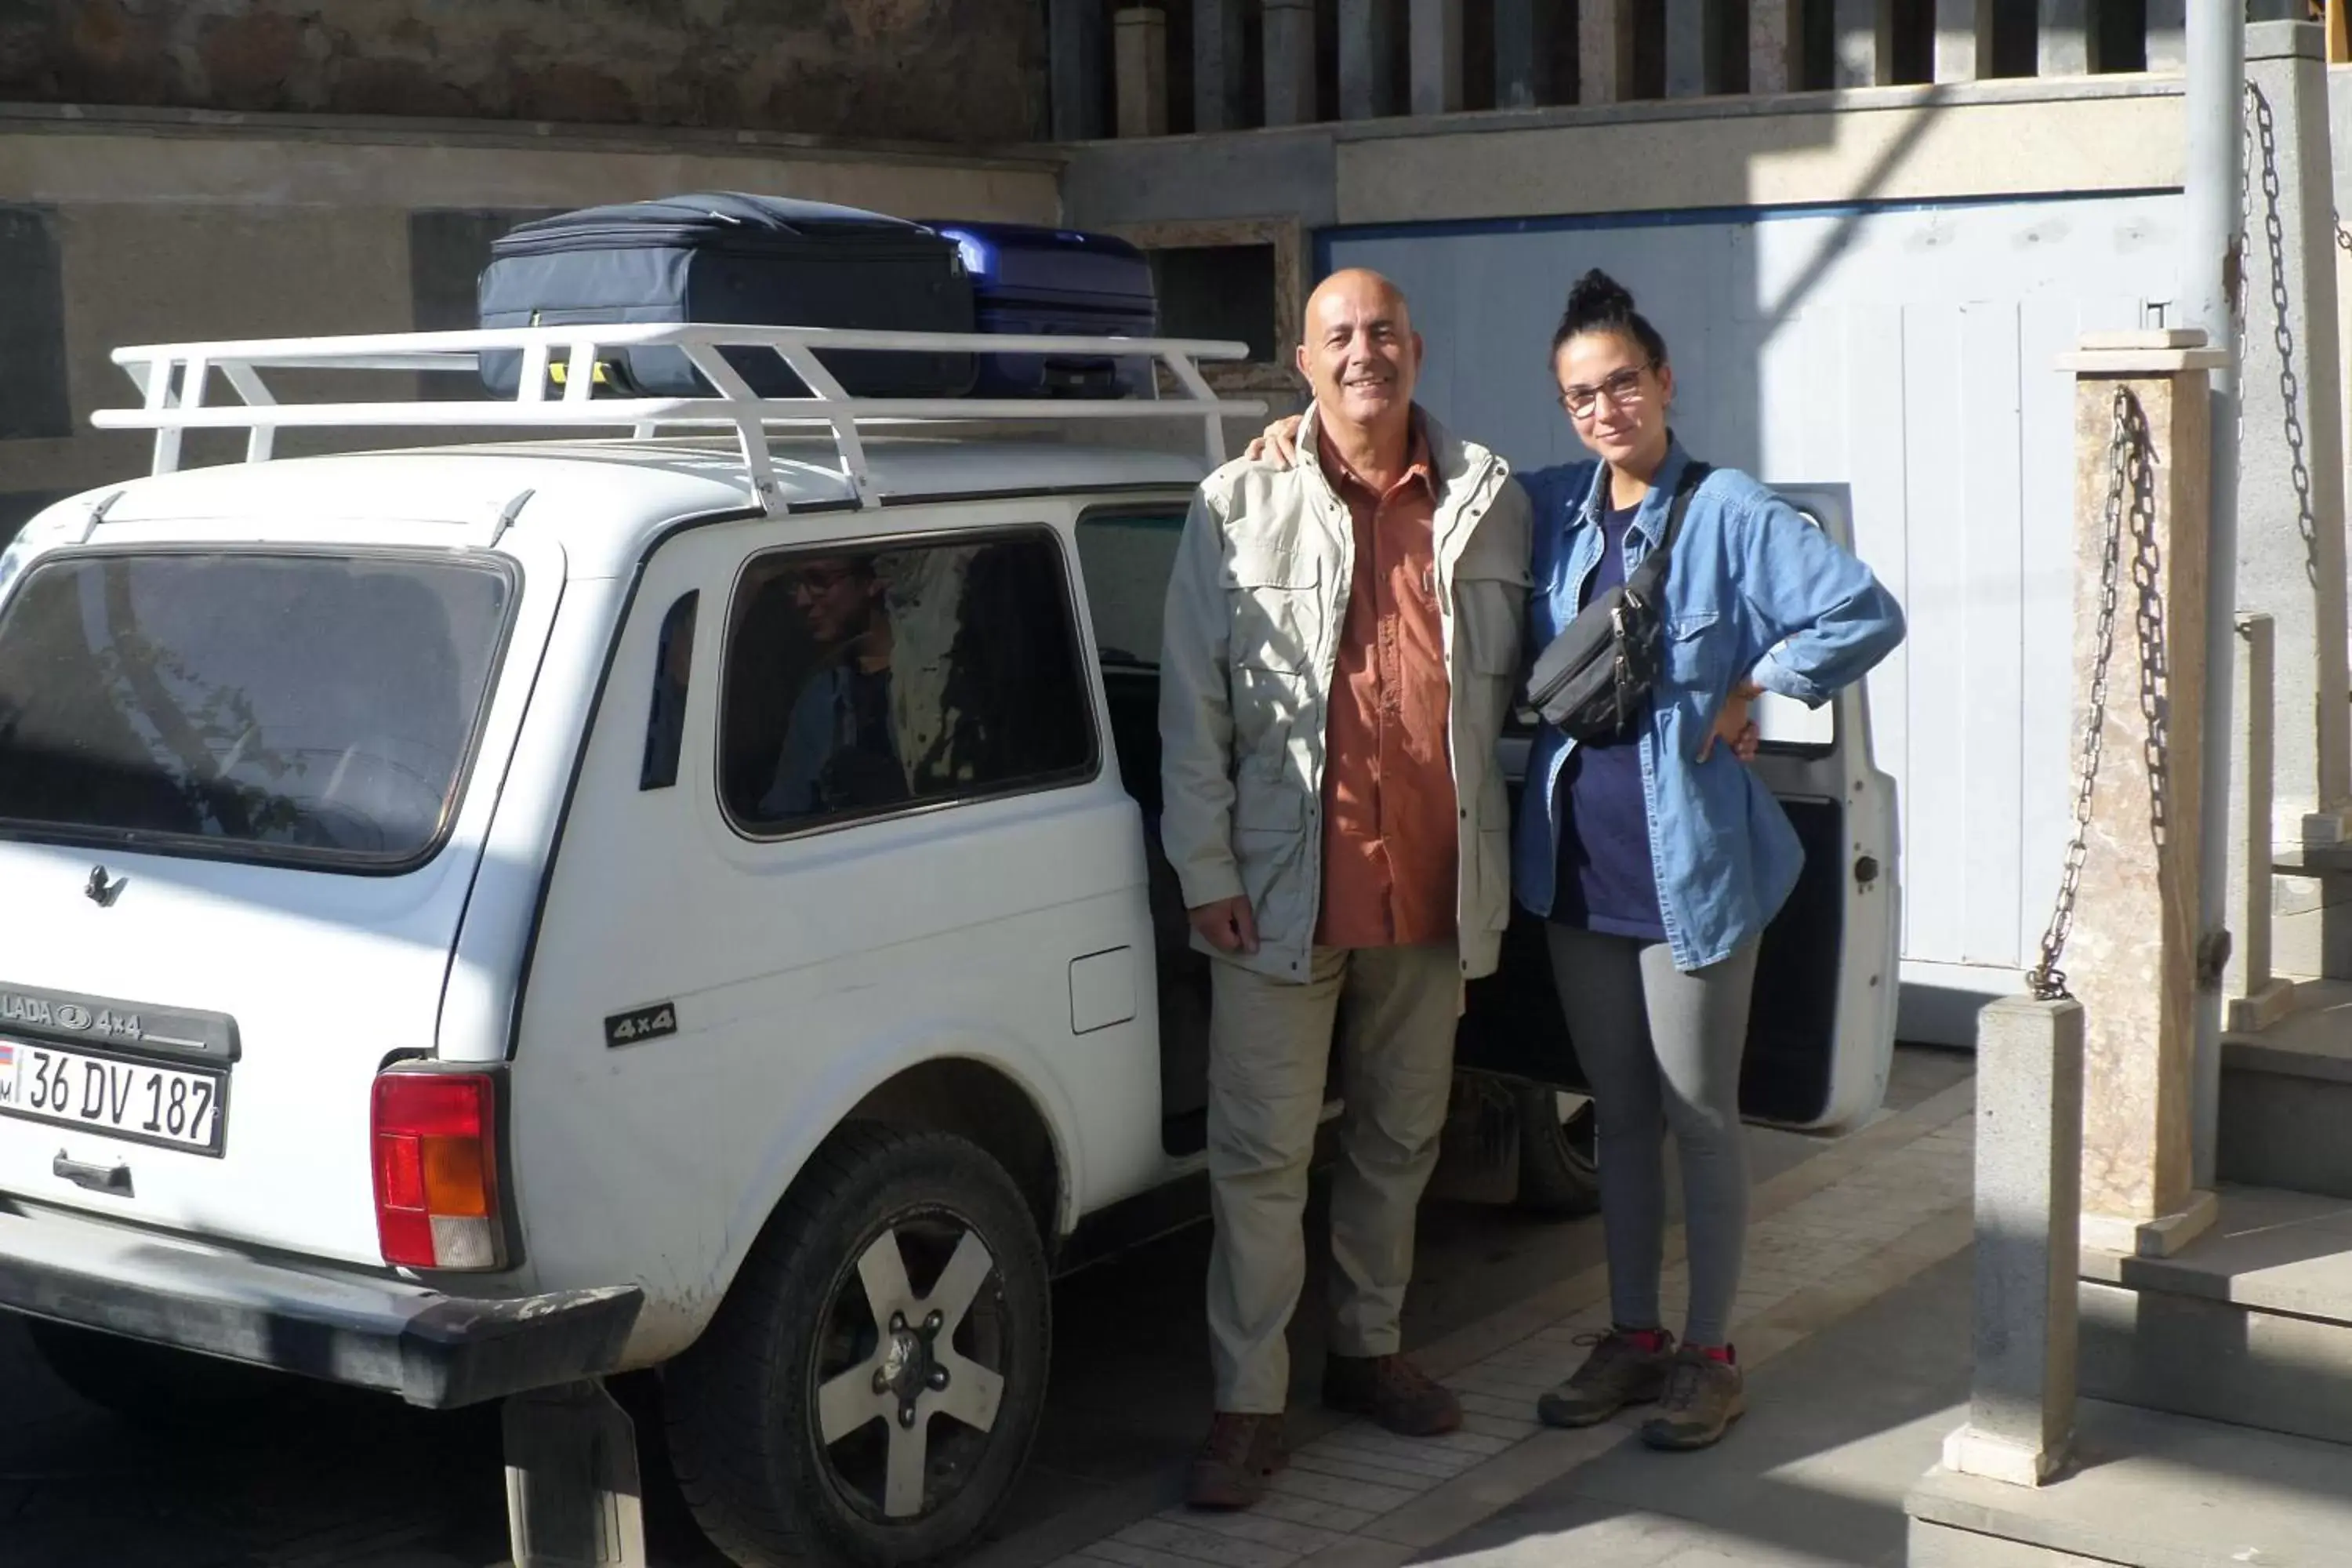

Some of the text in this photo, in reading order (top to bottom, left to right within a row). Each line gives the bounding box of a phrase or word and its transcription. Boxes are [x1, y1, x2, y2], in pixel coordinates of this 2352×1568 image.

[2, 994, 144, 1041] LADA 4x4
[613, 1009, 673, 1038] 4x4
[31, 1051, 212, 1139] 36 DV 187
